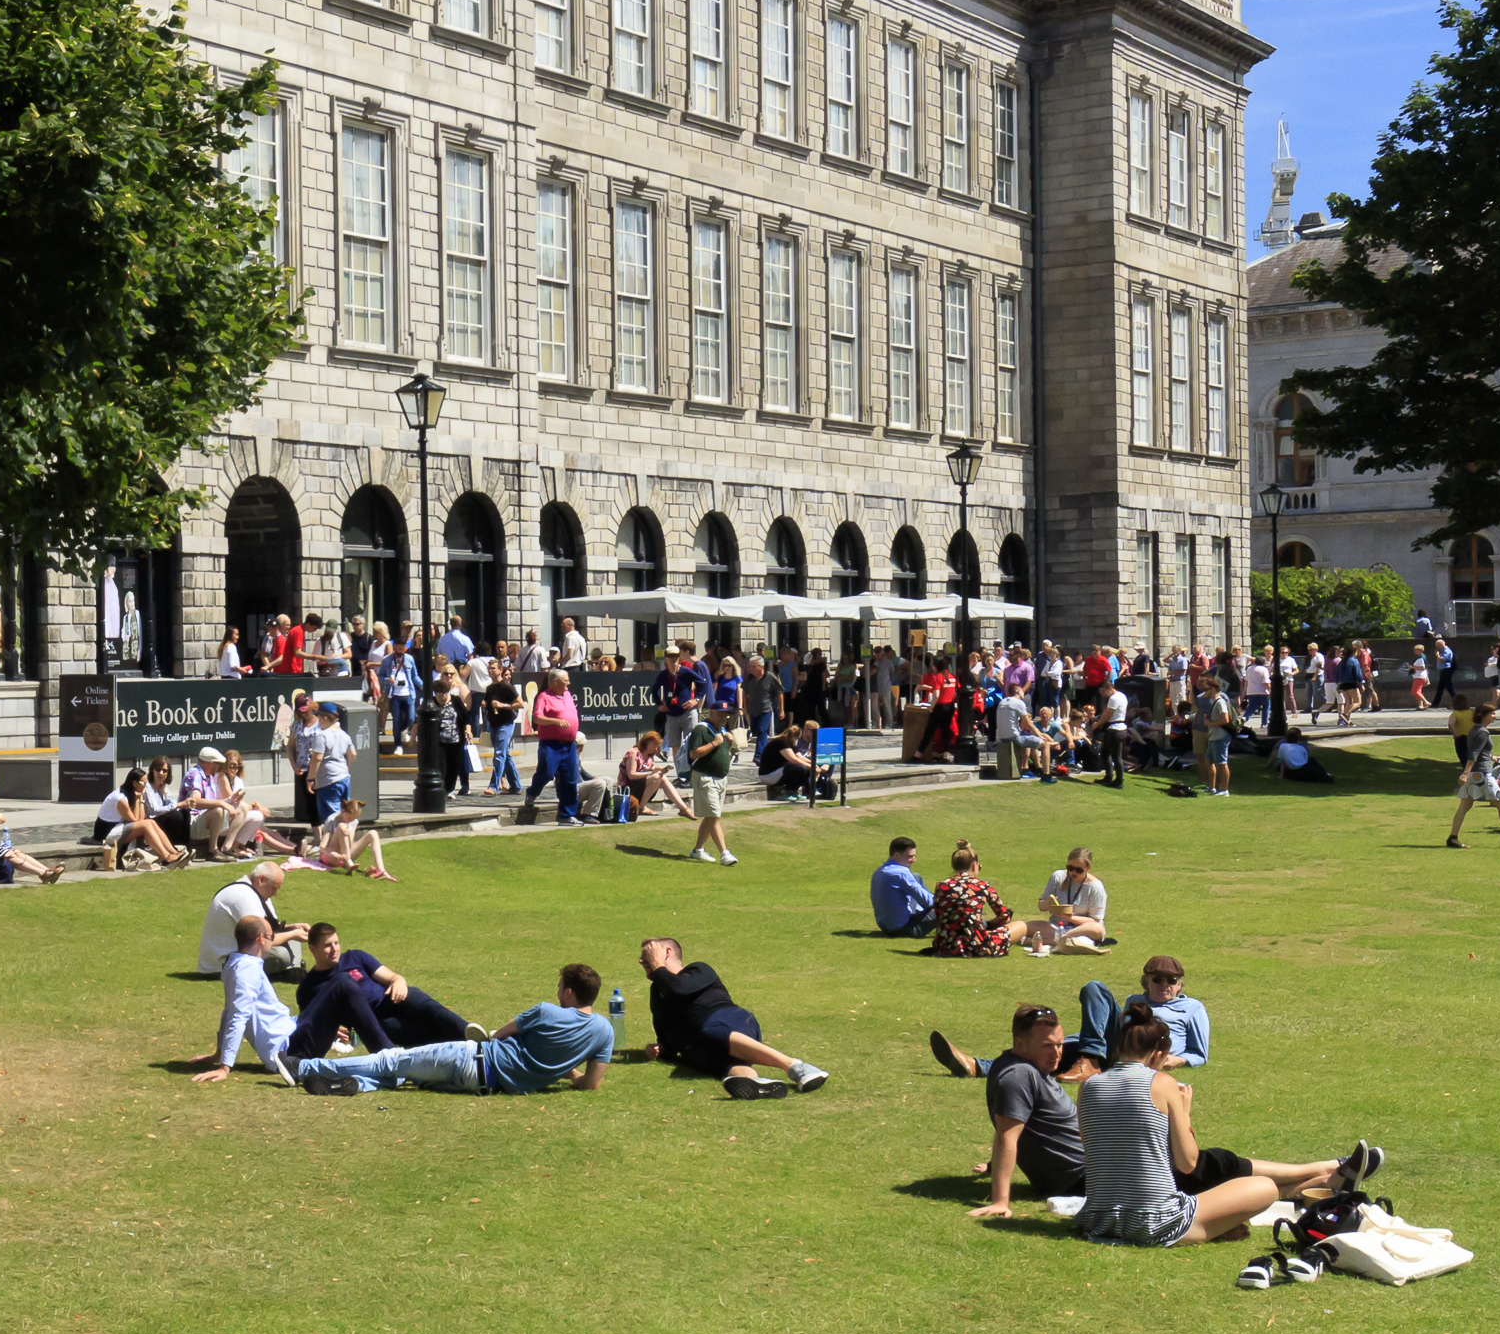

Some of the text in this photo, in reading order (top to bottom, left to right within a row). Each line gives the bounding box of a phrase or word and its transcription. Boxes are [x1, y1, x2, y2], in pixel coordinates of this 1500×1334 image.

[85, 686, 108, 694] Online
[582, 685, 618, 708] Book
[621, 685, 637, 707] of
[85, 696, 108, 705] Tickets
[116, 695, 276, 727] he Book of Kells
[142, 731, 236, 744] Trinity College Library Dublin
